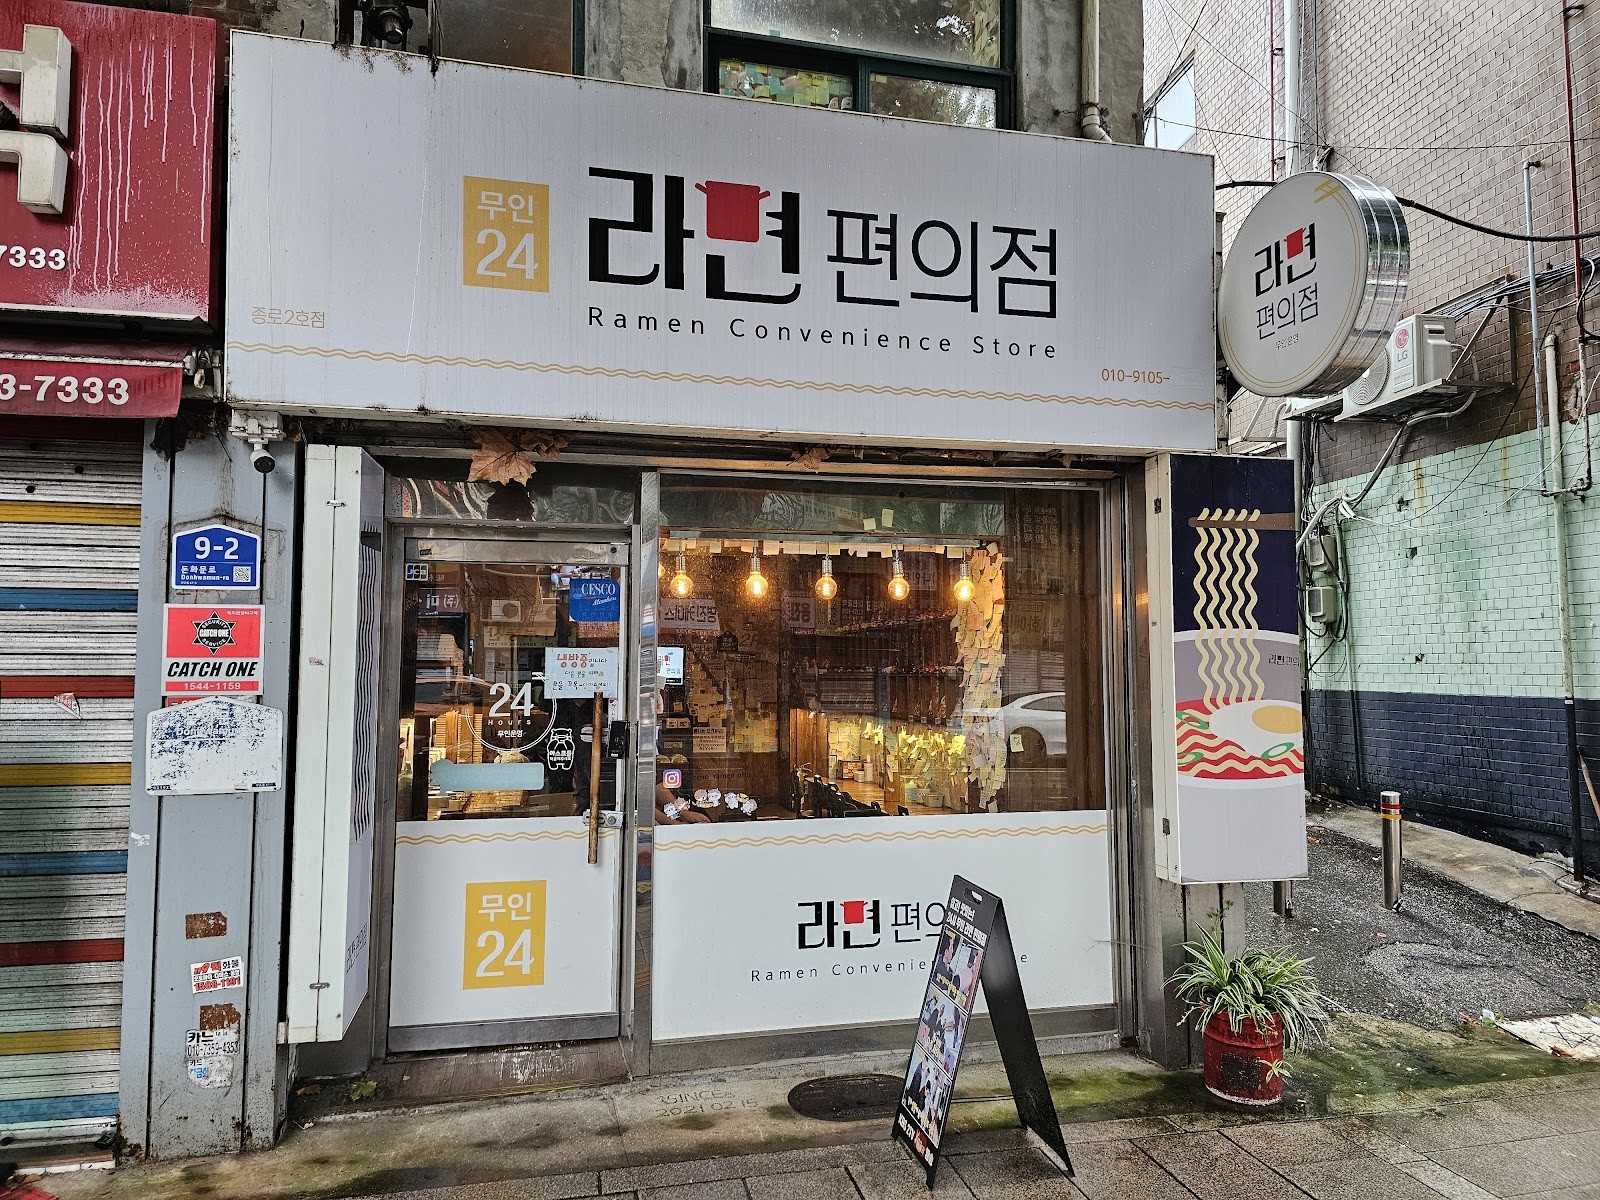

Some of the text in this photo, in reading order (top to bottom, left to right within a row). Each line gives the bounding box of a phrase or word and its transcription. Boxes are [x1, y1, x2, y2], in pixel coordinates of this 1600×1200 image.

[476, 190, 534, 224] 무인
[588, 167, 1057, 320] 라면 편의점
[476, 228, 538, 280] 24
[1254, 222, 1318, 297] 라면
[251, 306, 326, 330] 종로2호점
[1256, 284, 1319, 340] 편의점
[588, 306, 1057, 359] Ramen Convenience Store
[1396, 350, 1409, 362] LG
[1101, 368, 1170, 384] 010-9105-
[194, 536, 239, 560] 9-2
[181, 565, 217, 574] 돈화문로
[581, 583, 616, 595] CESCO
[201, 619, 228, 629] SECURITY
[199, 629, 230, 638] CATCH ONE
[202, 638, 227, 647] SERVICE
[167, 661, 259, 677] CATCH ONE
[184, 682, 241, 691] 1544-1159
[489, 682, 534, 717] 24
[497, 729, 523, 738] 무인운영
[478, 892, 532, 923] 무인
[797, 899, 881, 950] 라면
[475, 928, 535, 978] 24
[751, 966, 818, 982] Ramen
[667, 1090, 723, 1104] SINCE
[655, 1105, 705, 1118] 2021
[711, 1101, 736, 1111] 02
